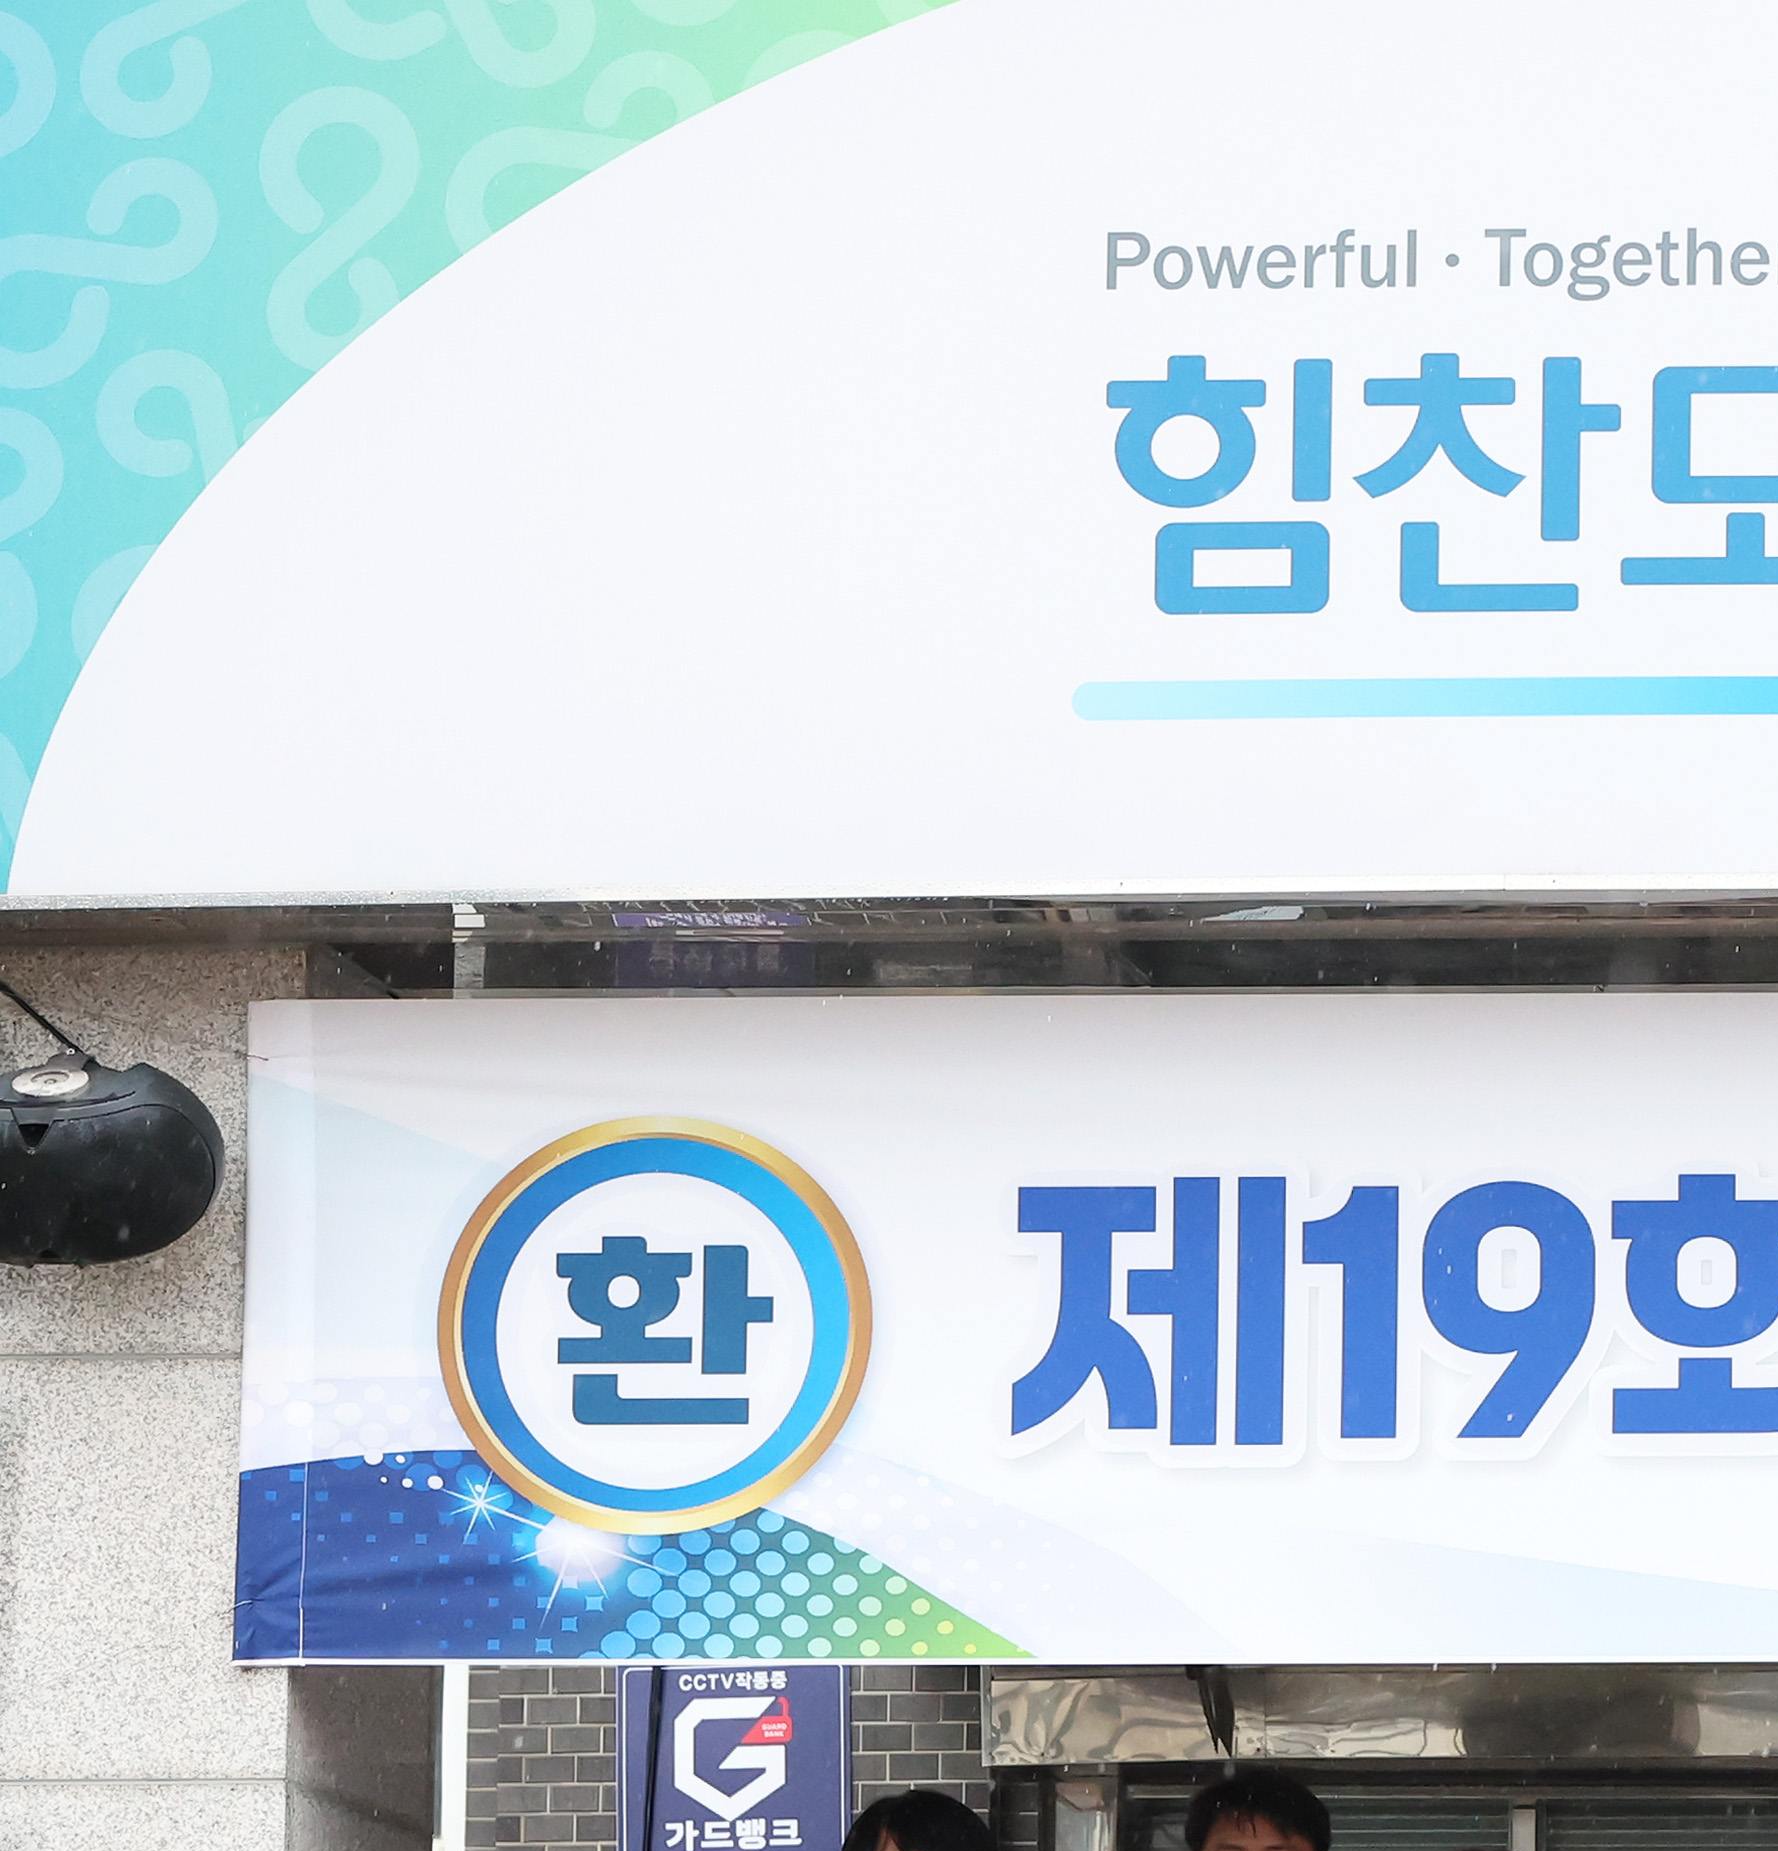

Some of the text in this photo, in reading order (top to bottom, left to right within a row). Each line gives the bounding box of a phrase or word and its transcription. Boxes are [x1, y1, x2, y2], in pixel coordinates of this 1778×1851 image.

[1105, 227, 1419, 292] Powerful
[556, 1234, 775, 1426] 환
[664, 1817, 803, 1851] 가드뱅크
